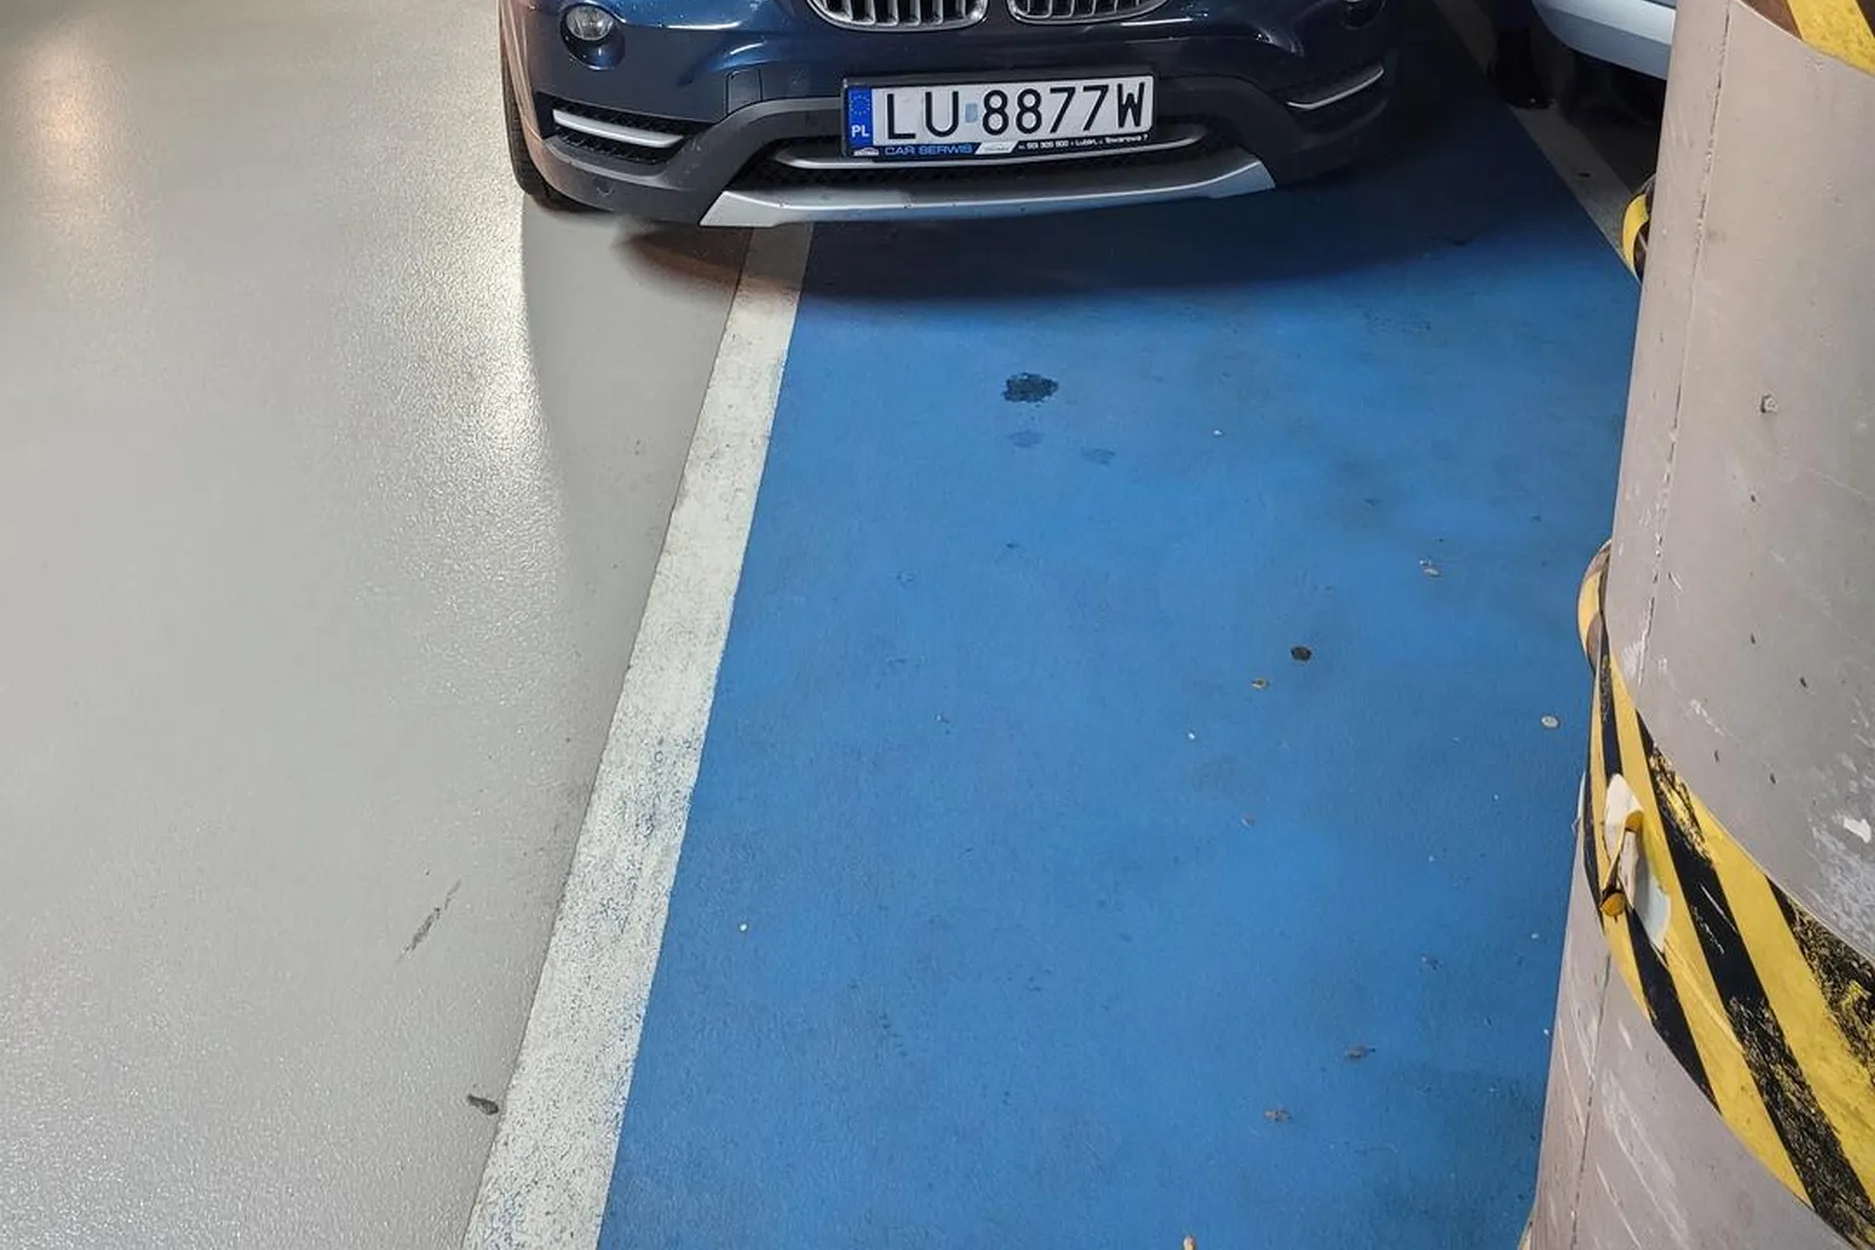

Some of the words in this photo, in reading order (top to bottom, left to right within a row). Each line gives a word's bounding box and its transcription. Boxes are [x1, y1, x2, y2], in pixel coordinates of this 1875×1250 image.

[886, 91, 960, 140] LU
[981, 82, 1146, 135] 8877W
[851, 125, 870, 138] PL
[884, 146, 916, 156] CAR
[919, 144, 973, 155] SERWIS
